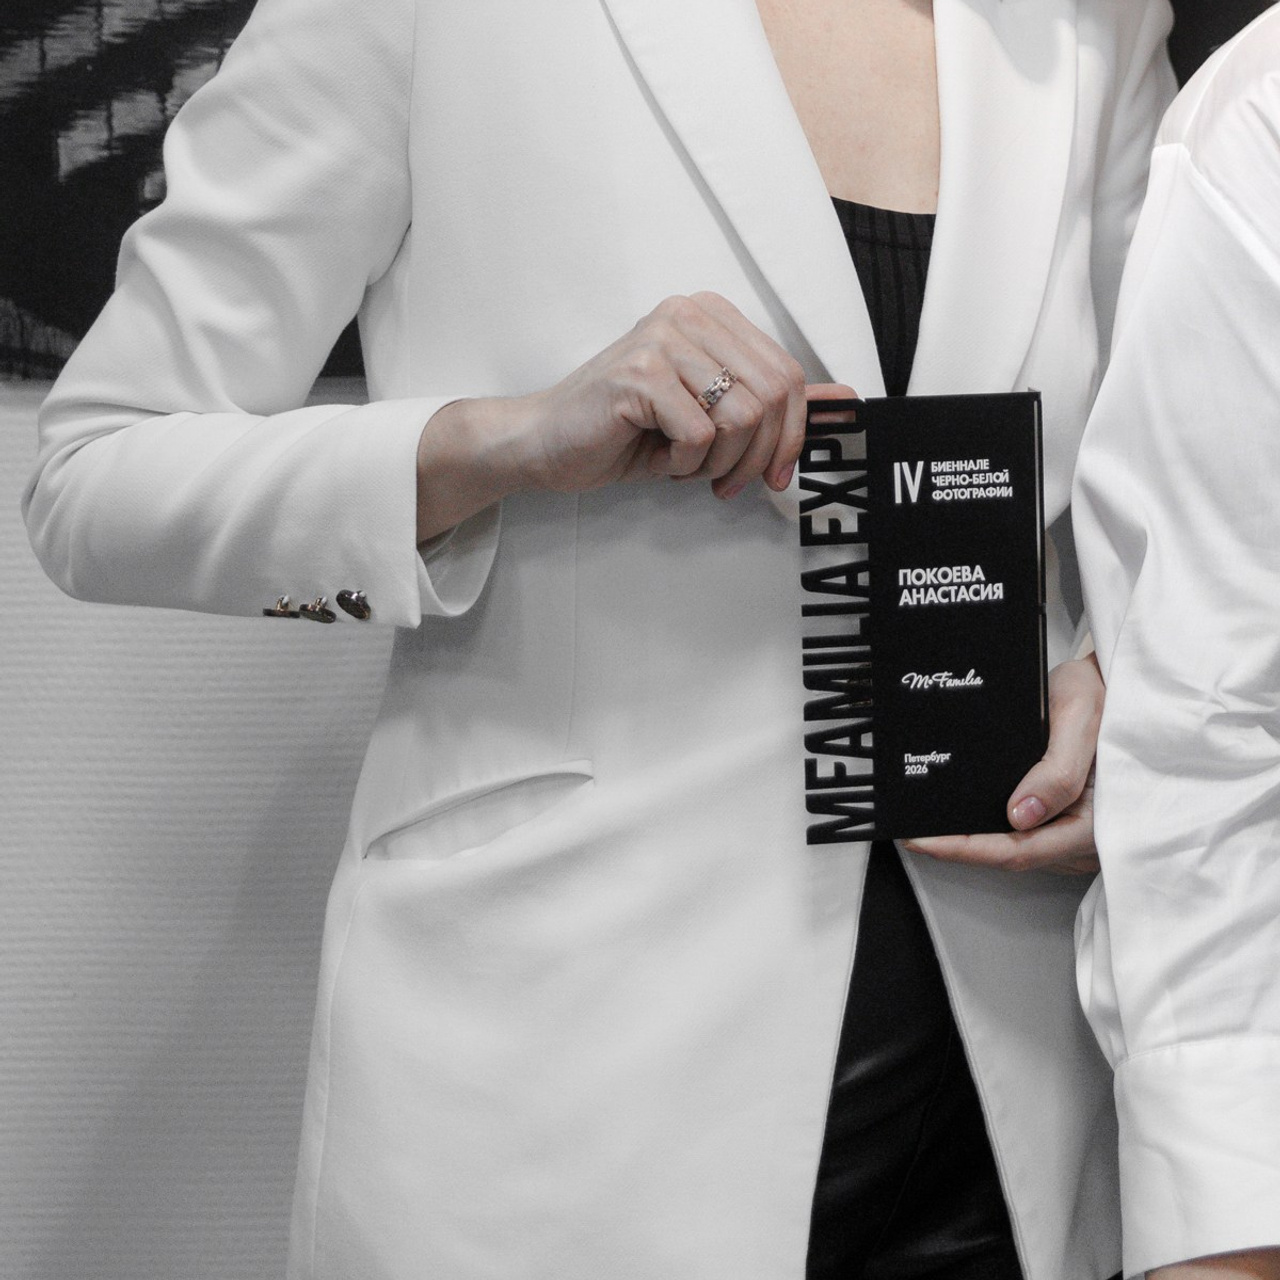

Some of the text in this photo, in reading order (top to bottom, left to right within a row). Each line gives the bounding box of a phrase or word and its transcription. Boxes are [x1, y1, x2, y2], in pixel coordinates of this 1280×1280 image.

[931, 458, 990, 473] БИЕННАЛЕ
[893, 460, 925, 504] IV
[931, 469, 1010, 487] ЧЕРНО-БЕЛОЙ
[931, 486, 1013, 501] ФОТОГРАФИИ
[899, 565, 986, 586] ПОКОЕВА
[899, 582, 1004, 606] АНАСТАСИЯ
[800, 560, 875, 845] MFAMILIA
[904, 751, 952, 764] Петербург
[904, 764, 929, 775] 2026
